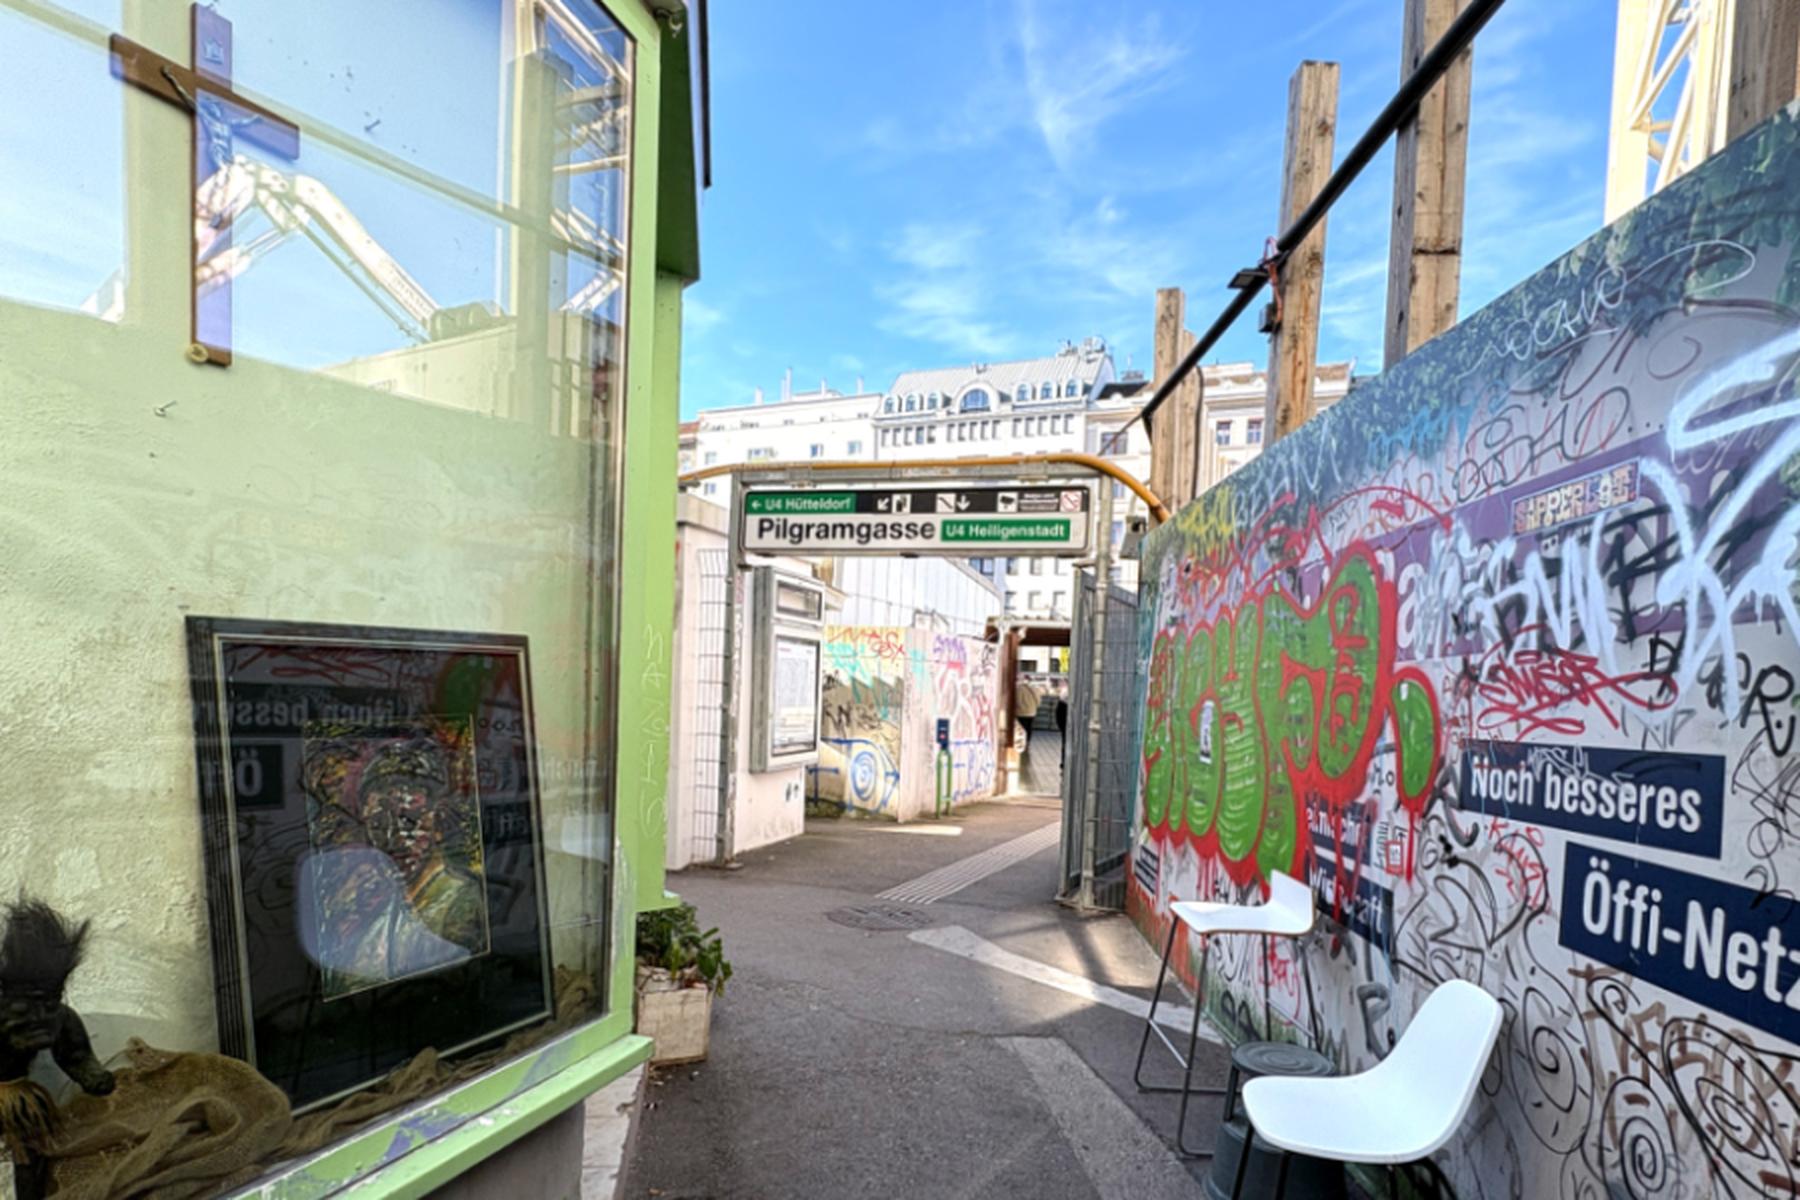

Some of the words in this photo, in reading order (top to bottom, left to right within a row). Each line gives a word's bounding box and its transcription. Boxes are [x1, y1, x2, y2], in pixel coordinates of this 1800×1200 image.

[765, 499, 783, 510] U4
[785, 497, 851, 510] Hütteldorf
[758, 517, 935, 545] Pilgramgasse
[946, 525, 965, 536] U4
[969, 523, 1065, 539] Heiligenstadt
[1471, 756, 1533, 806] Noch
[1544, 765, 1702, 834] besseres
